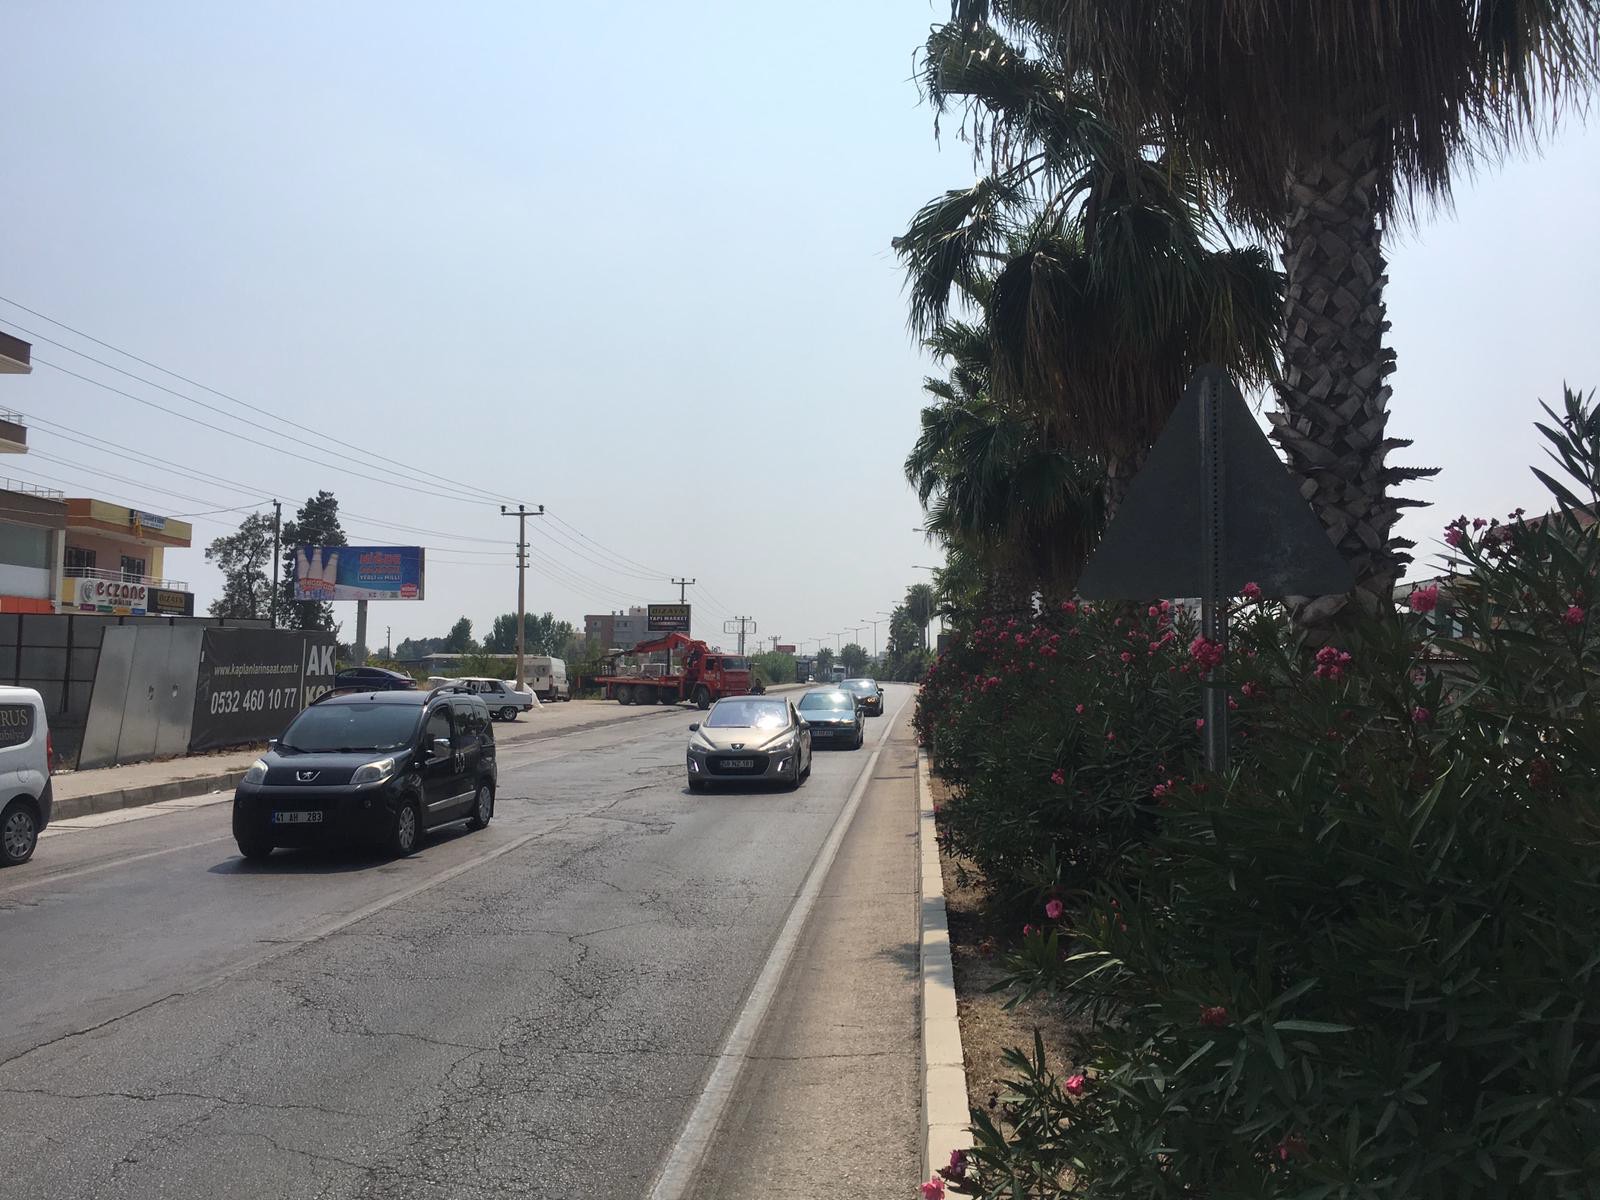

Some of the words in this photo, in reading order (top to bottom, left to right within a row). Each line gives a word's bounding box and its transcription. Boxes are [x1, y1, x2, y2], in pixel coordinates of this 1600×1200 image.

[96, 581, 146, 600] eczane
[210, 690, 240, 715] 0532
[242, 689, 265, 712] 460
[268, 688, 281, 710] 10
[284, 688, 297, 708] 77
